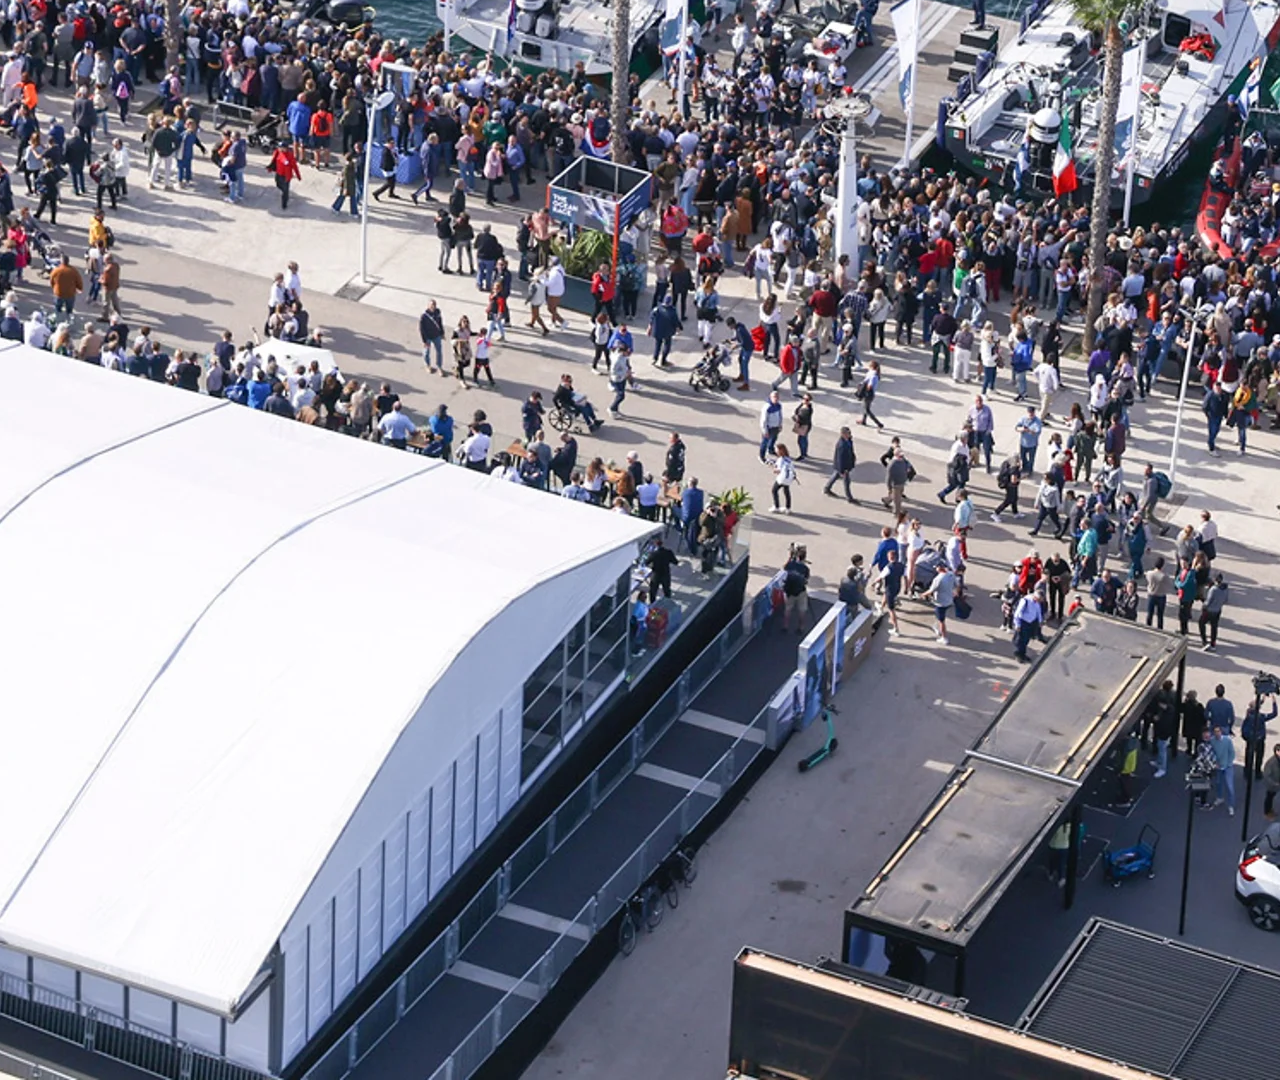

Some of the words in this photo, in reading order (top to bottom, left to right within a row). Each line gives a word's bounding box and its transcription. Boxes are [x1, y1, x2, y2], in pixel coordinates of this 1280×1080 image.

[552, 193, 568, 203] THE
[552, 200, 579, 212] OCEAN
[552, 206, 572, 217] RACE
